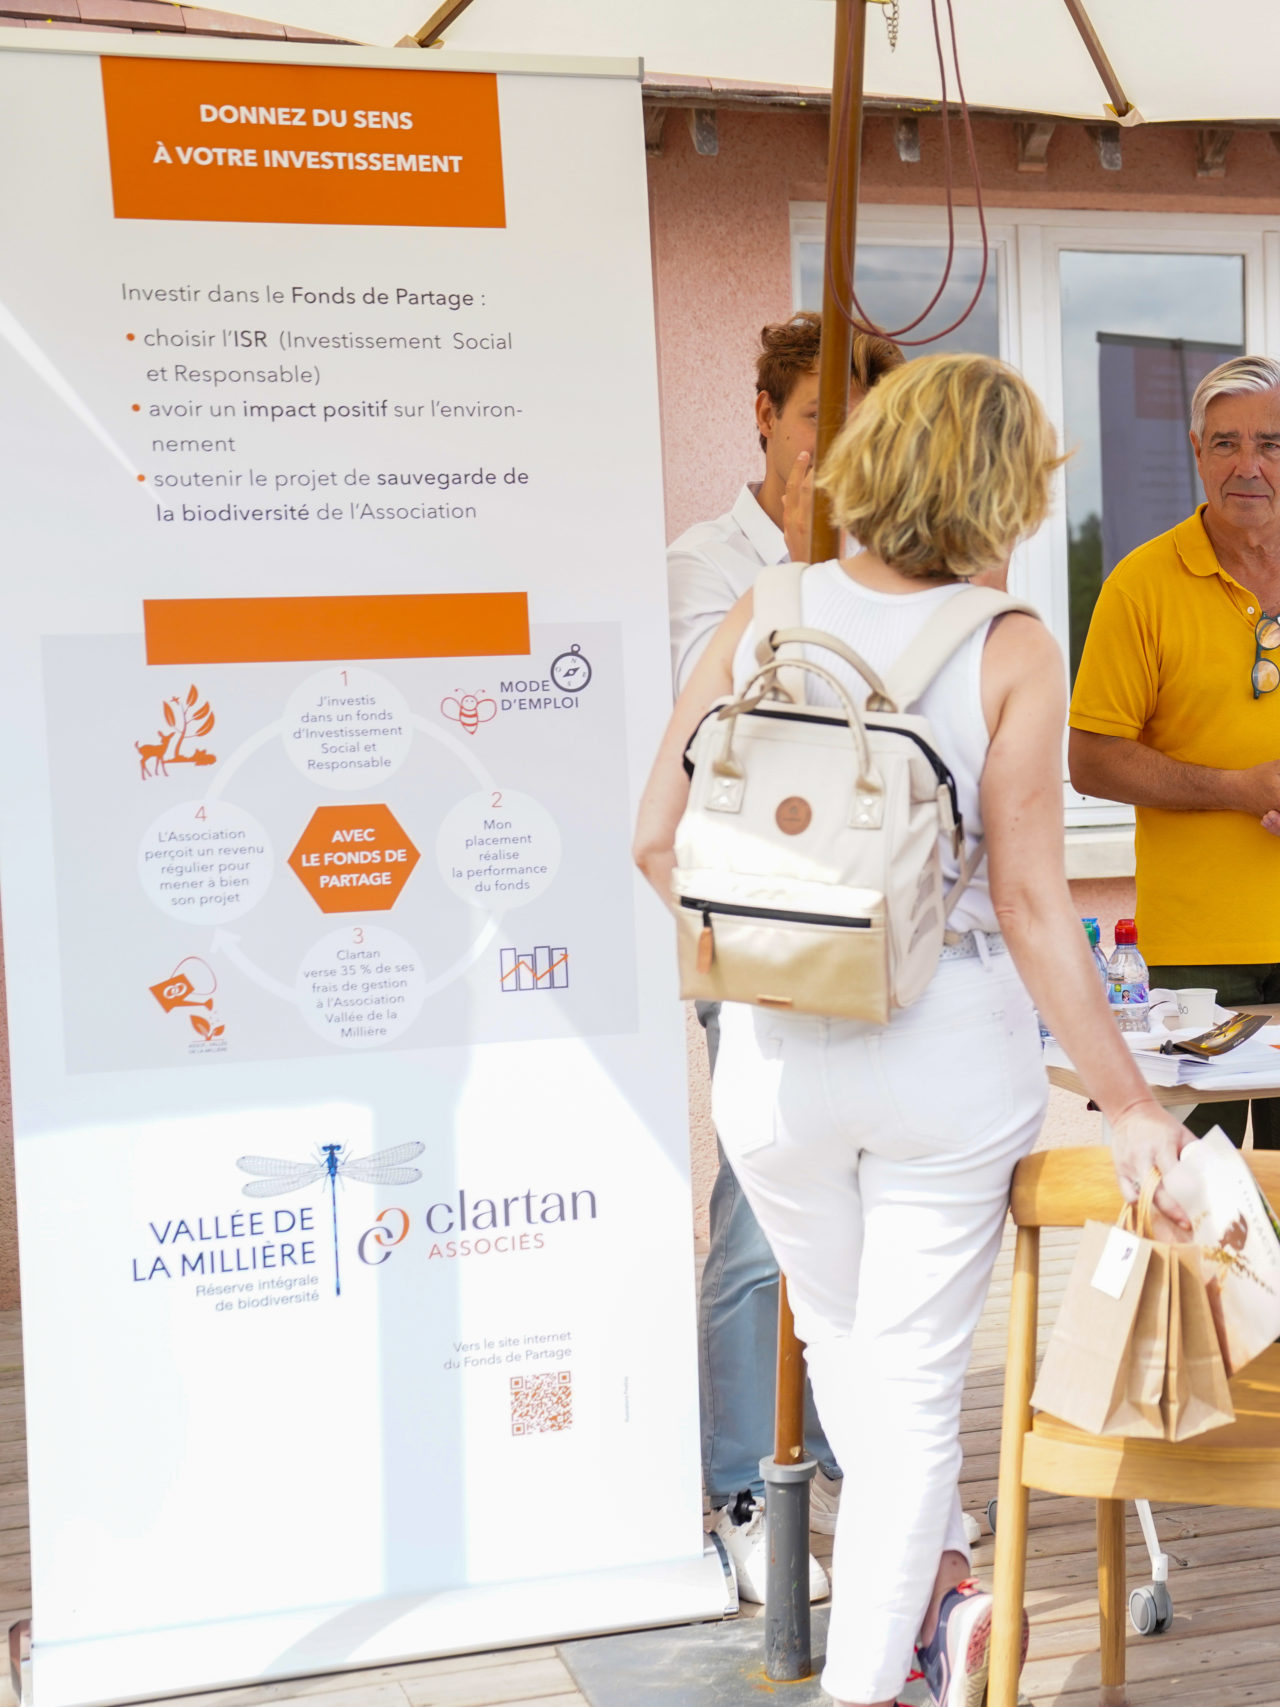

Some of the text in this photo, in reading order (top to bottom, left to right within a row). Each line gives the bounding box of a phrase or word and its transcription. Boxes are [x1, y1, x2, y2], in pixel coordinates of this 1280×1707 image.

[200, 104, 413, 129] DONNEZ DU SENS
[153, 141, 463, 173] À VOTRE INVESTISSEMENT
[122, 283, 200, 302] Investir
[208, 284, 259, 303] dans
[267, 285, 284, 303] le
[292, 287, 355, 304] Fonds
[363, 287, 389, 304] de
[396, 288, 473, 310] Partage
[144, 328, 511, 351] choisir l'ISR (Investissement Social
[147, 365, 320, 387] et Responsable)
[149, 400, 522, 422] avoir un impact positif sur l'environ-
[153, 437, 236, 452] nement
[154, 467, 528, 491] soutenir le projet de sauvegarde de
[157, 502, 476, 521] la biodiversité de l'Association
[340, 670, 347, 686] 1
[500, 680, 550, 692] MODE
[317, 695, 376, 707] J'investis
[501, 697, 578, 710] D'EMPLOI
[301, 709, 393, 723] dans un fonds
[293, 726, 402, 739] d'Investissement
[320, 741, 376, 755] Social et
[308, 756, 391, 772] Responsable
[491, 792, 502, 808] 2
[195, 806, 207, 822] 4
[484, 819, 511, 830] Mon
[158, 830, 246, 842] L'Association
[332, 828, 375, 843] AVEC
[466, 835, 532, 849] placement
[145, 846, 264, 862] perçoit un revenu
[302, 849, 407, 867] LE FONDS DE
[479, 849, 519, 861] réalise
[161, 862, 250, 876] régulier pour
[452, 865, 547, 880] la performance
[160, 876, 249, 890] mener à bien
[320, 872, 392, 888] PARTAGE
[475, 879, 530, 892] du fonds
[171, 893, 240, 907] son projet
[353, 928, 364, 944] 3
[337, 950, 380, 960] Clartan
[304, 963, 415, 978] verse 35 % de ses
[312, 979, 407, 993] frais de gestion
[316, 996, 405, 1008] à l'Association
[325, 1009, 397, 1023] Vallée de la
[341, 1027, 387, 1038] Millière
[425, 1189, 598, 1235] clartan
[149, 1207, 314, 1244] VALLÉE DE
[428, 1232, 545, 1260] ASSOCIÉS
[133, 1241, 315, 1282] LA MILLIÈRE
[196, 1273, 319, 1298] Réserve intégrale
[215, 1289, 319, 1313] de biodiversité
[453, 1330, 572, 1353] Vers le site internet
[444, 1346, 572, 1369] du Fonds de Partage
